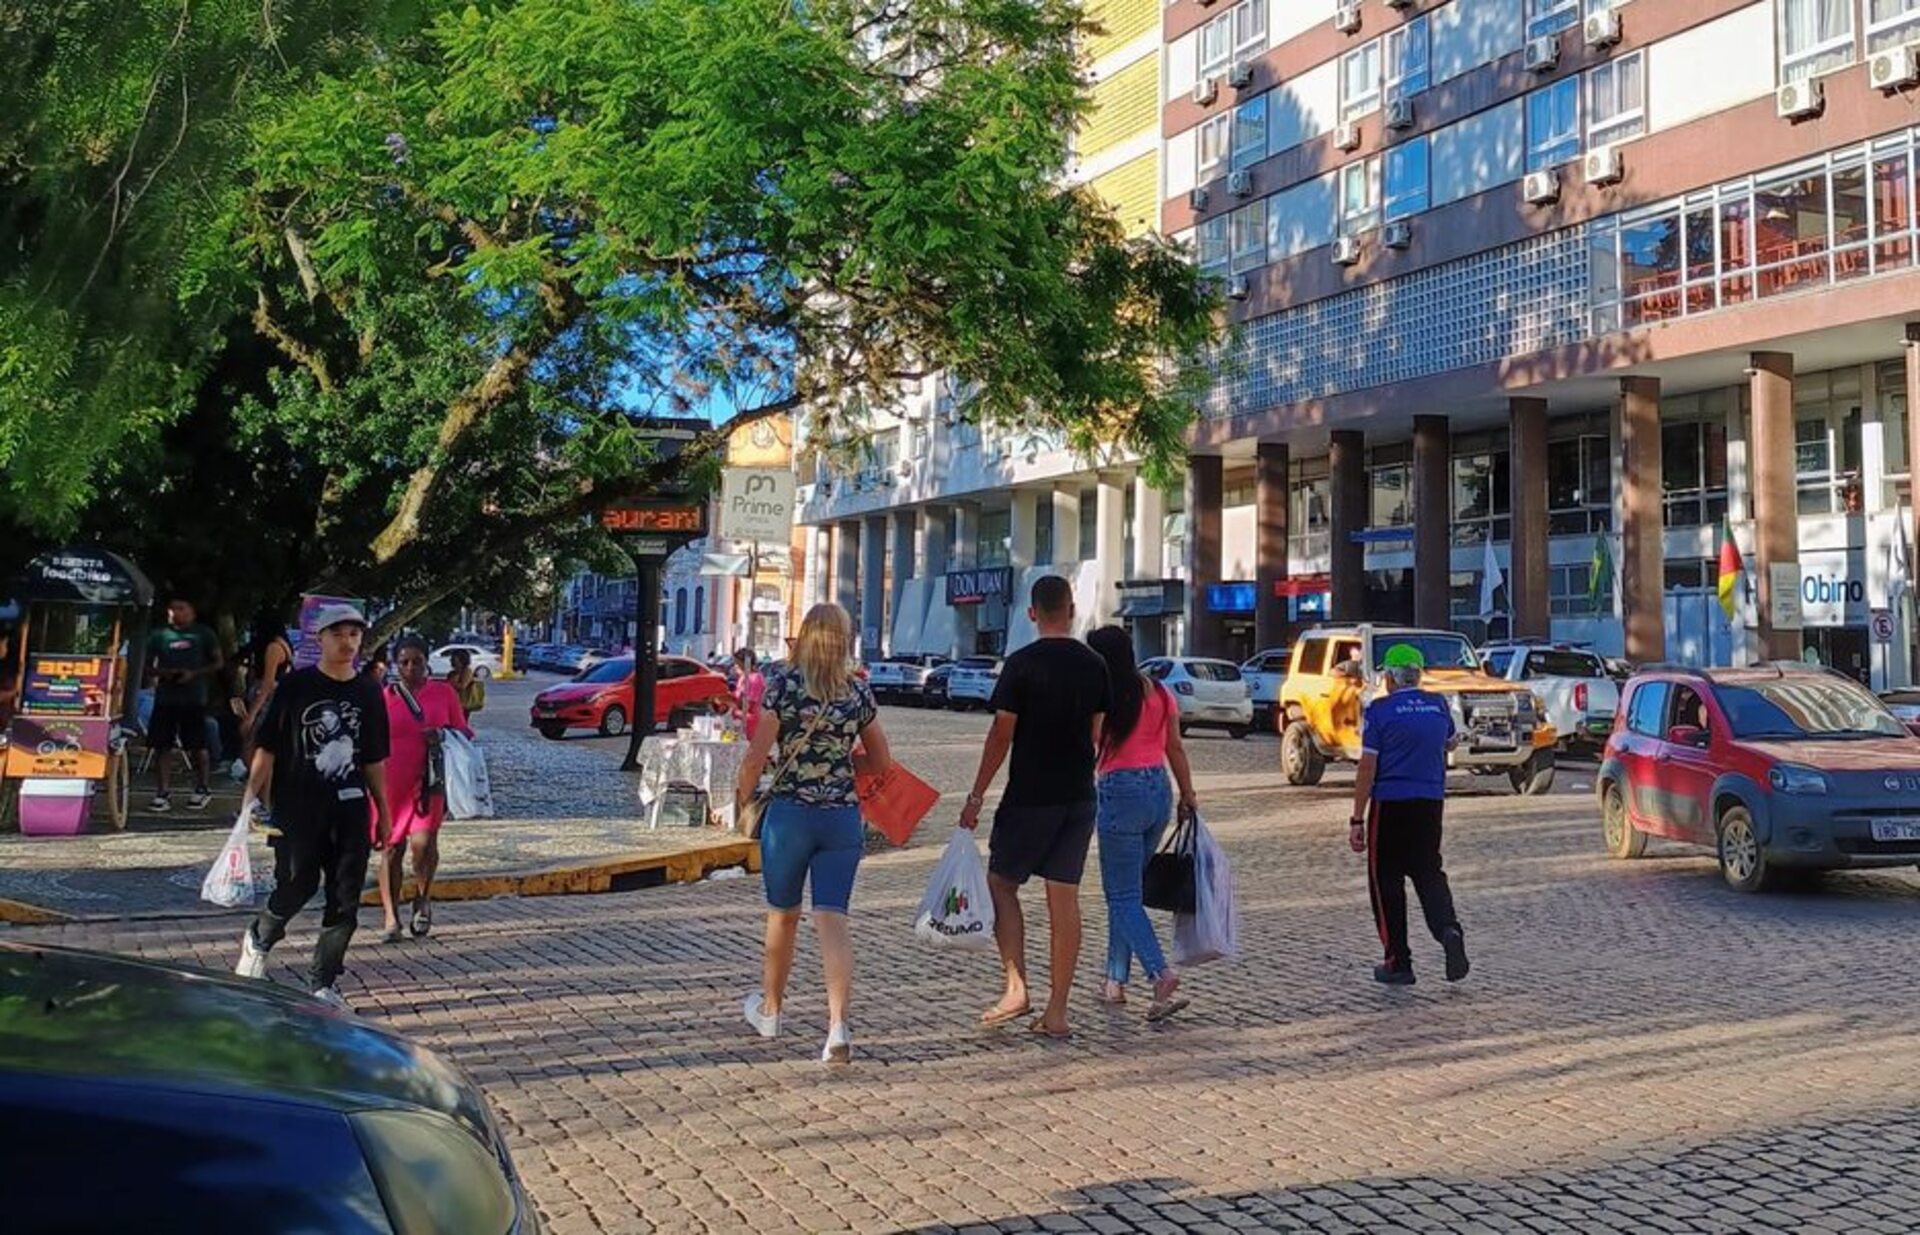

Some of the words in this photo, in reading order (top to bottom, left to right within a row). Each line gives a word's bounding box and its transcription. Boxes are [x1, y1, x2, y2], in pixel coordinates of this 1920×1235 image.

[732, 496, 784, 516] Prime
[953, 574, 976, 595] DON
[1802, 573, 1863, 603] Obino
